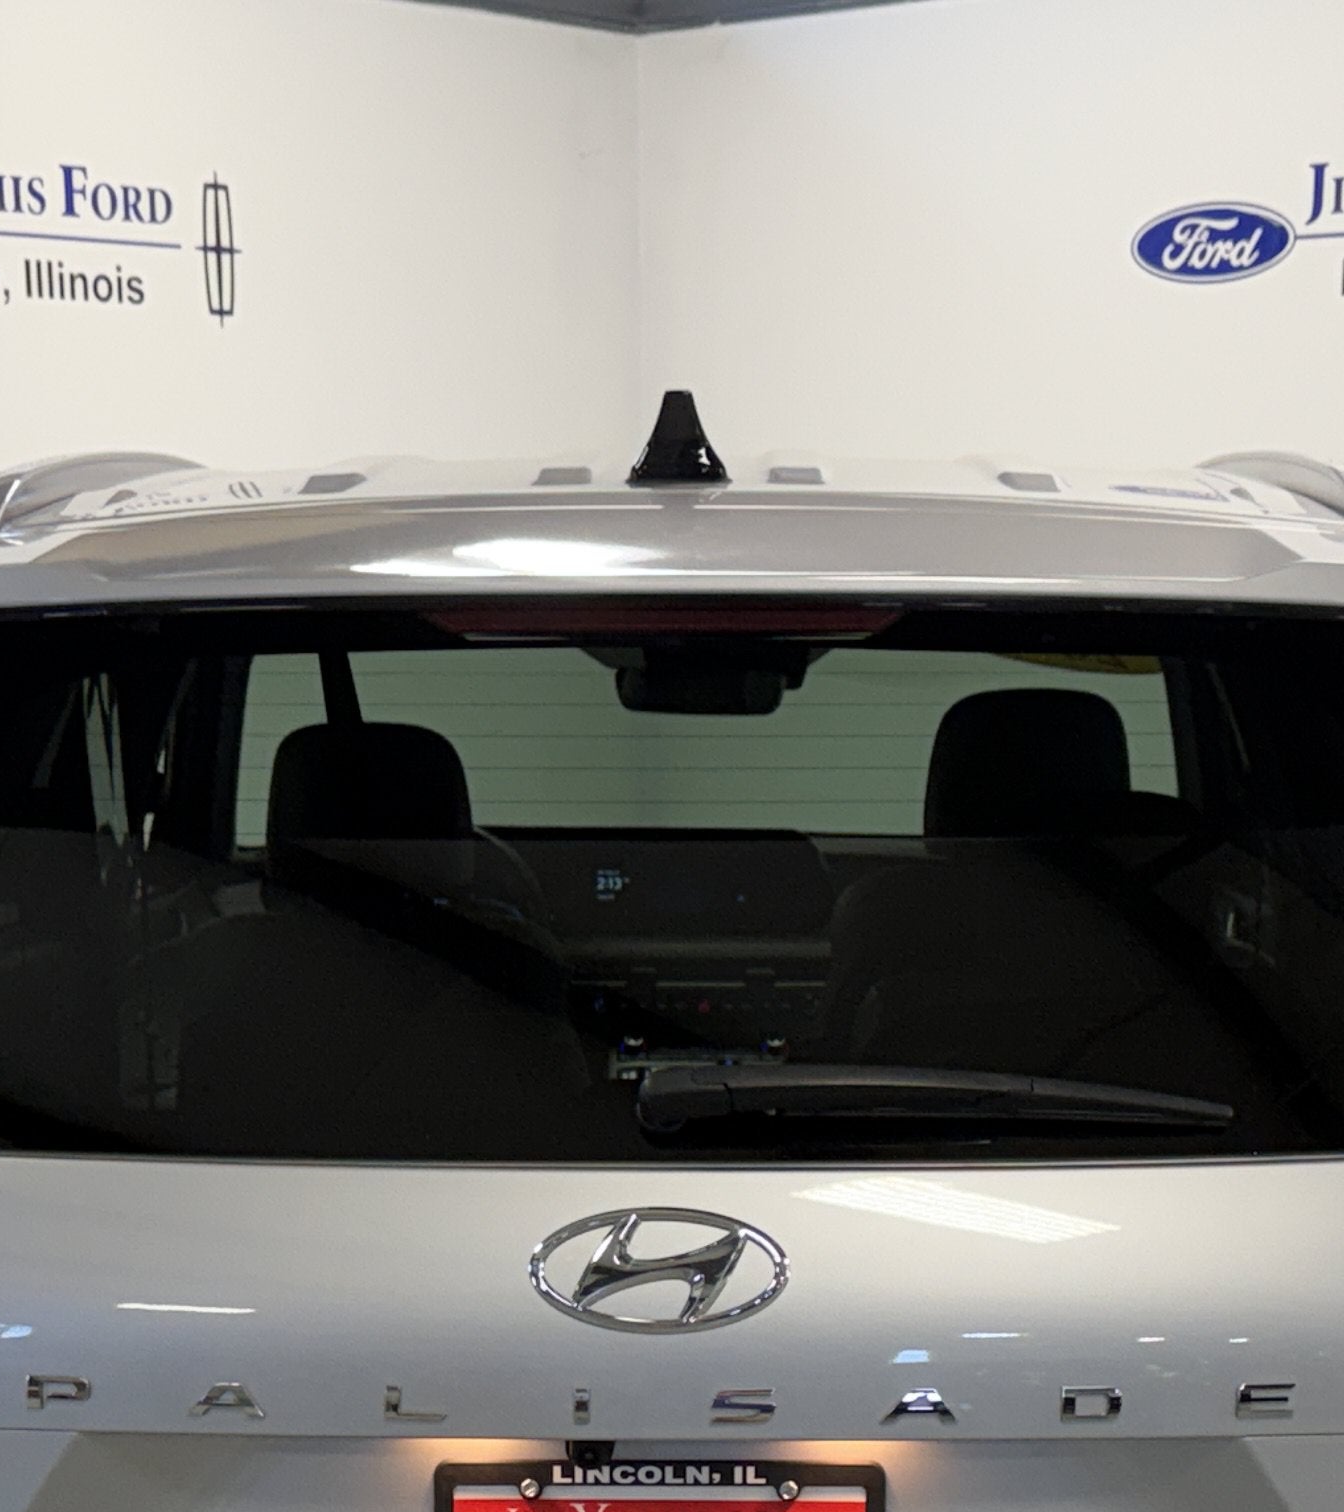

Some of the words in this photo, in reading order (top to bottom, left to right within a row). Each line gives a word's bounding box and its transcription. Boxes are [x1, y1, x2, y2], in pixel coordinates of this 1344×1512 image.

[1161, 216, 1259, 271] Ford
[24, 259, 145, 305] Illinois
[24, 1372, 1296, 1427] PALISADE
[552, 1465, 722, 1484] LINCOLN,
[734, 1465, 766, 1484] IL
